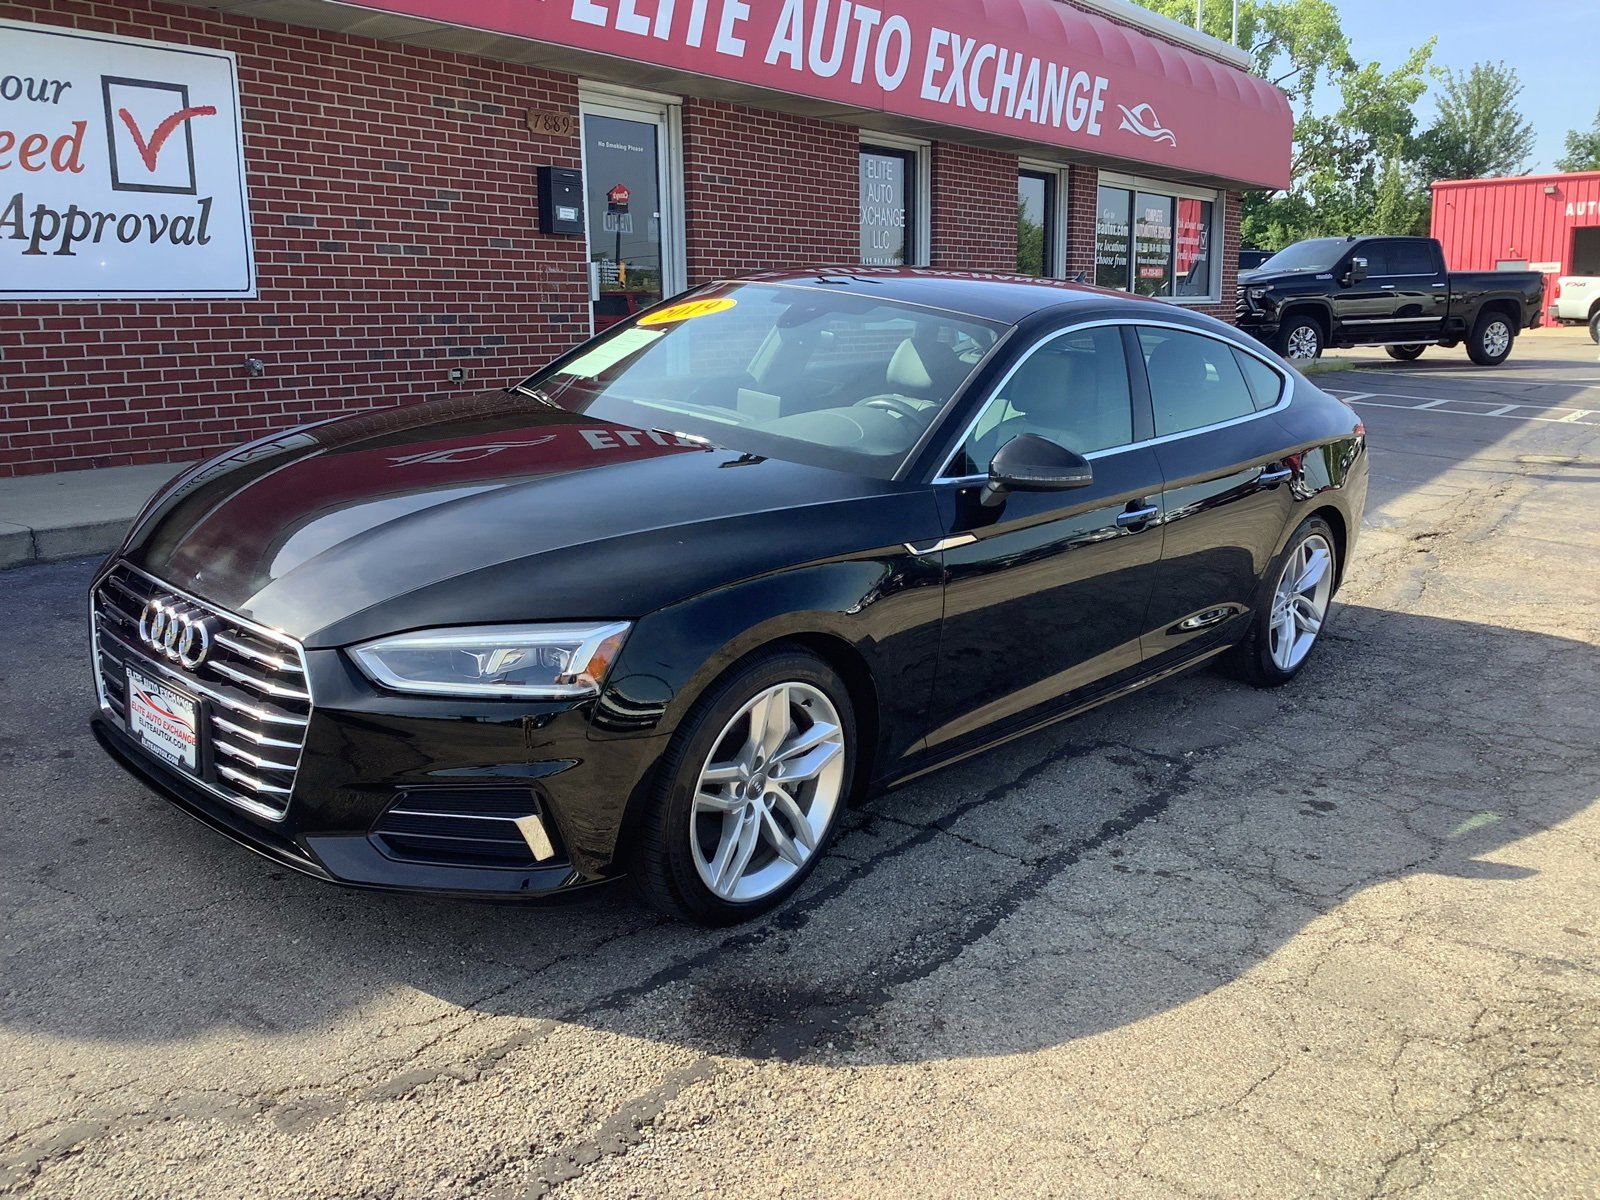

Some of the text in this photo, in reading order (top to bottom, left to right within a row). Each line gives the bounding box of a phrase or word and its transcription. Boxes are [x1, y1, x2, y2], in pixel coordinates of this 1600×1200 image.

[570, 0, 1108, 137] LITE AUTO EXCHANGE
[534, 114, 569, 134] 7889
[866, 160, 893, 180] ELITE
[867, 183, 893, 203] AUTO
[1565, 201, 1600, 217] AUT
[0, 192, 213, 256] Approval
[606, 214, 632, 232] OPEN
[873, 230, 890, 249] LLC
[1113, 254, 1127, 268] from
[131, 701, 197, 746] ELITE AUTO EXCHANGE
[138, 717, 187, 752] ELITEAUTOX.COM
